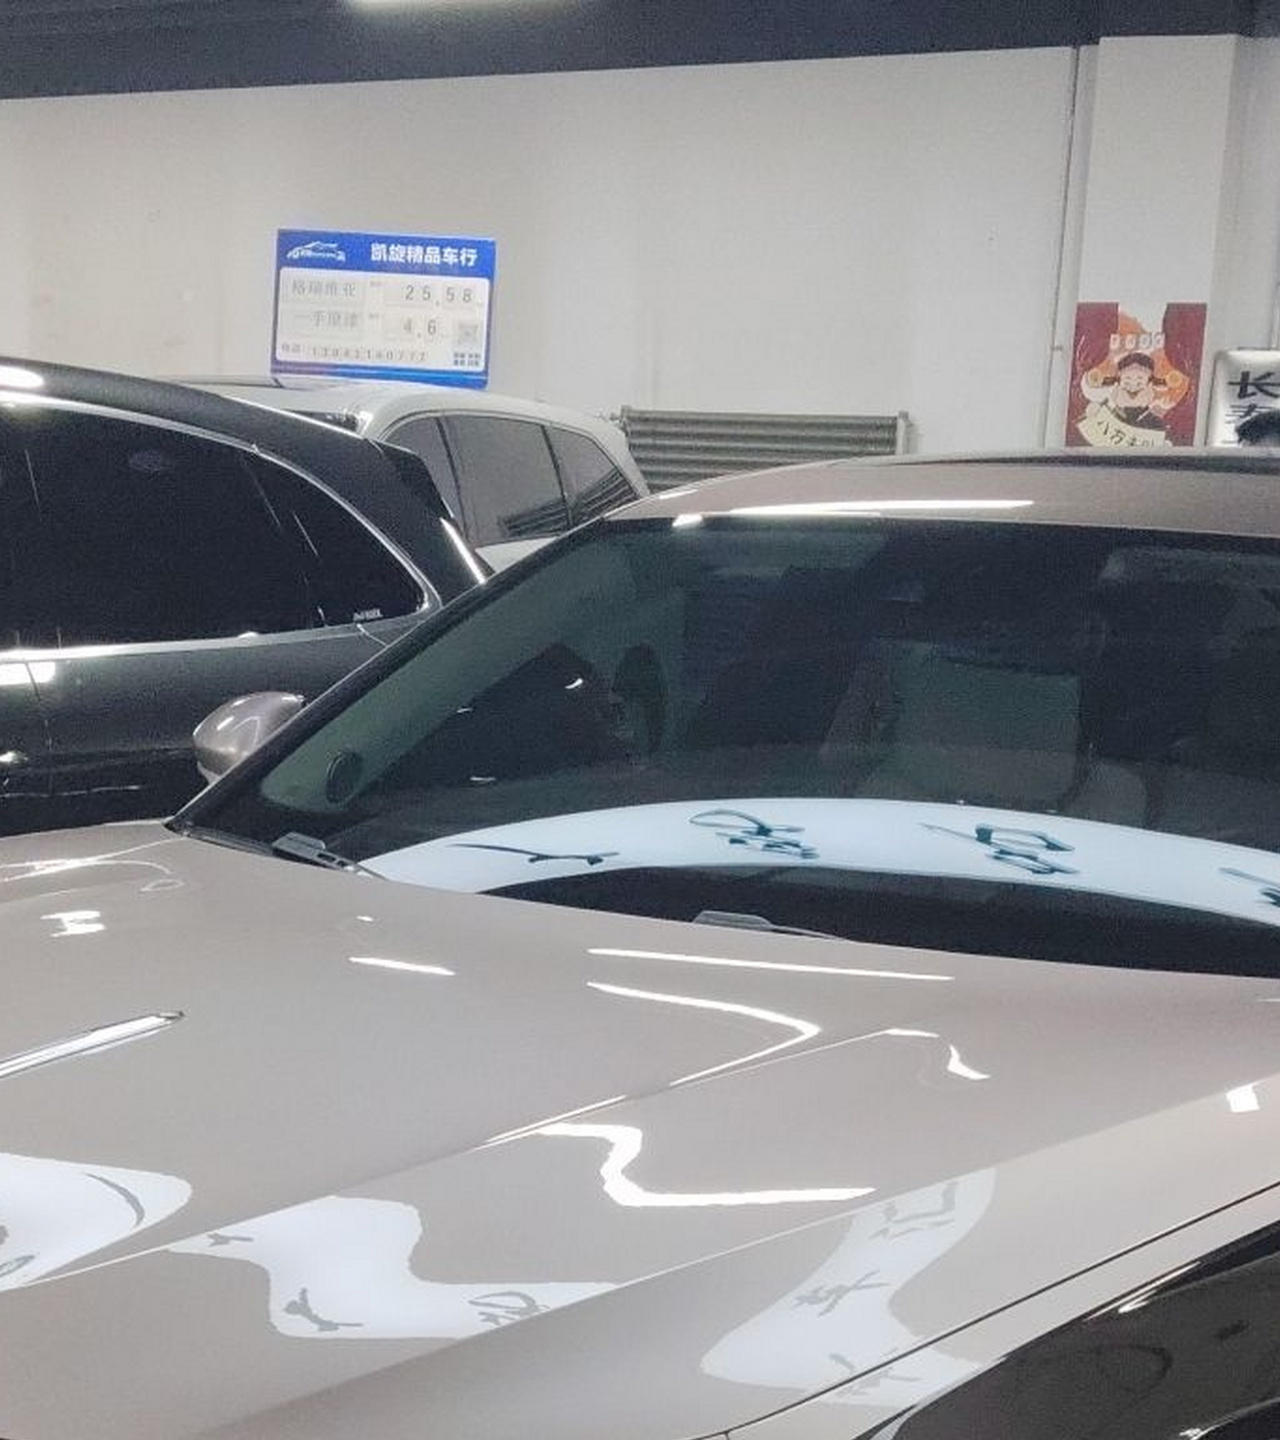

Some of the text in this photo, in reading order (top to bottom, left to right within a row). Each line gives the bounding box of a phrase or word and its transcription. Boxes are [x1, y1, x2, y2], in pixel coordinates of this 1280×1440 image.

[370, 242, 479, 267] 凯旋精品车行
